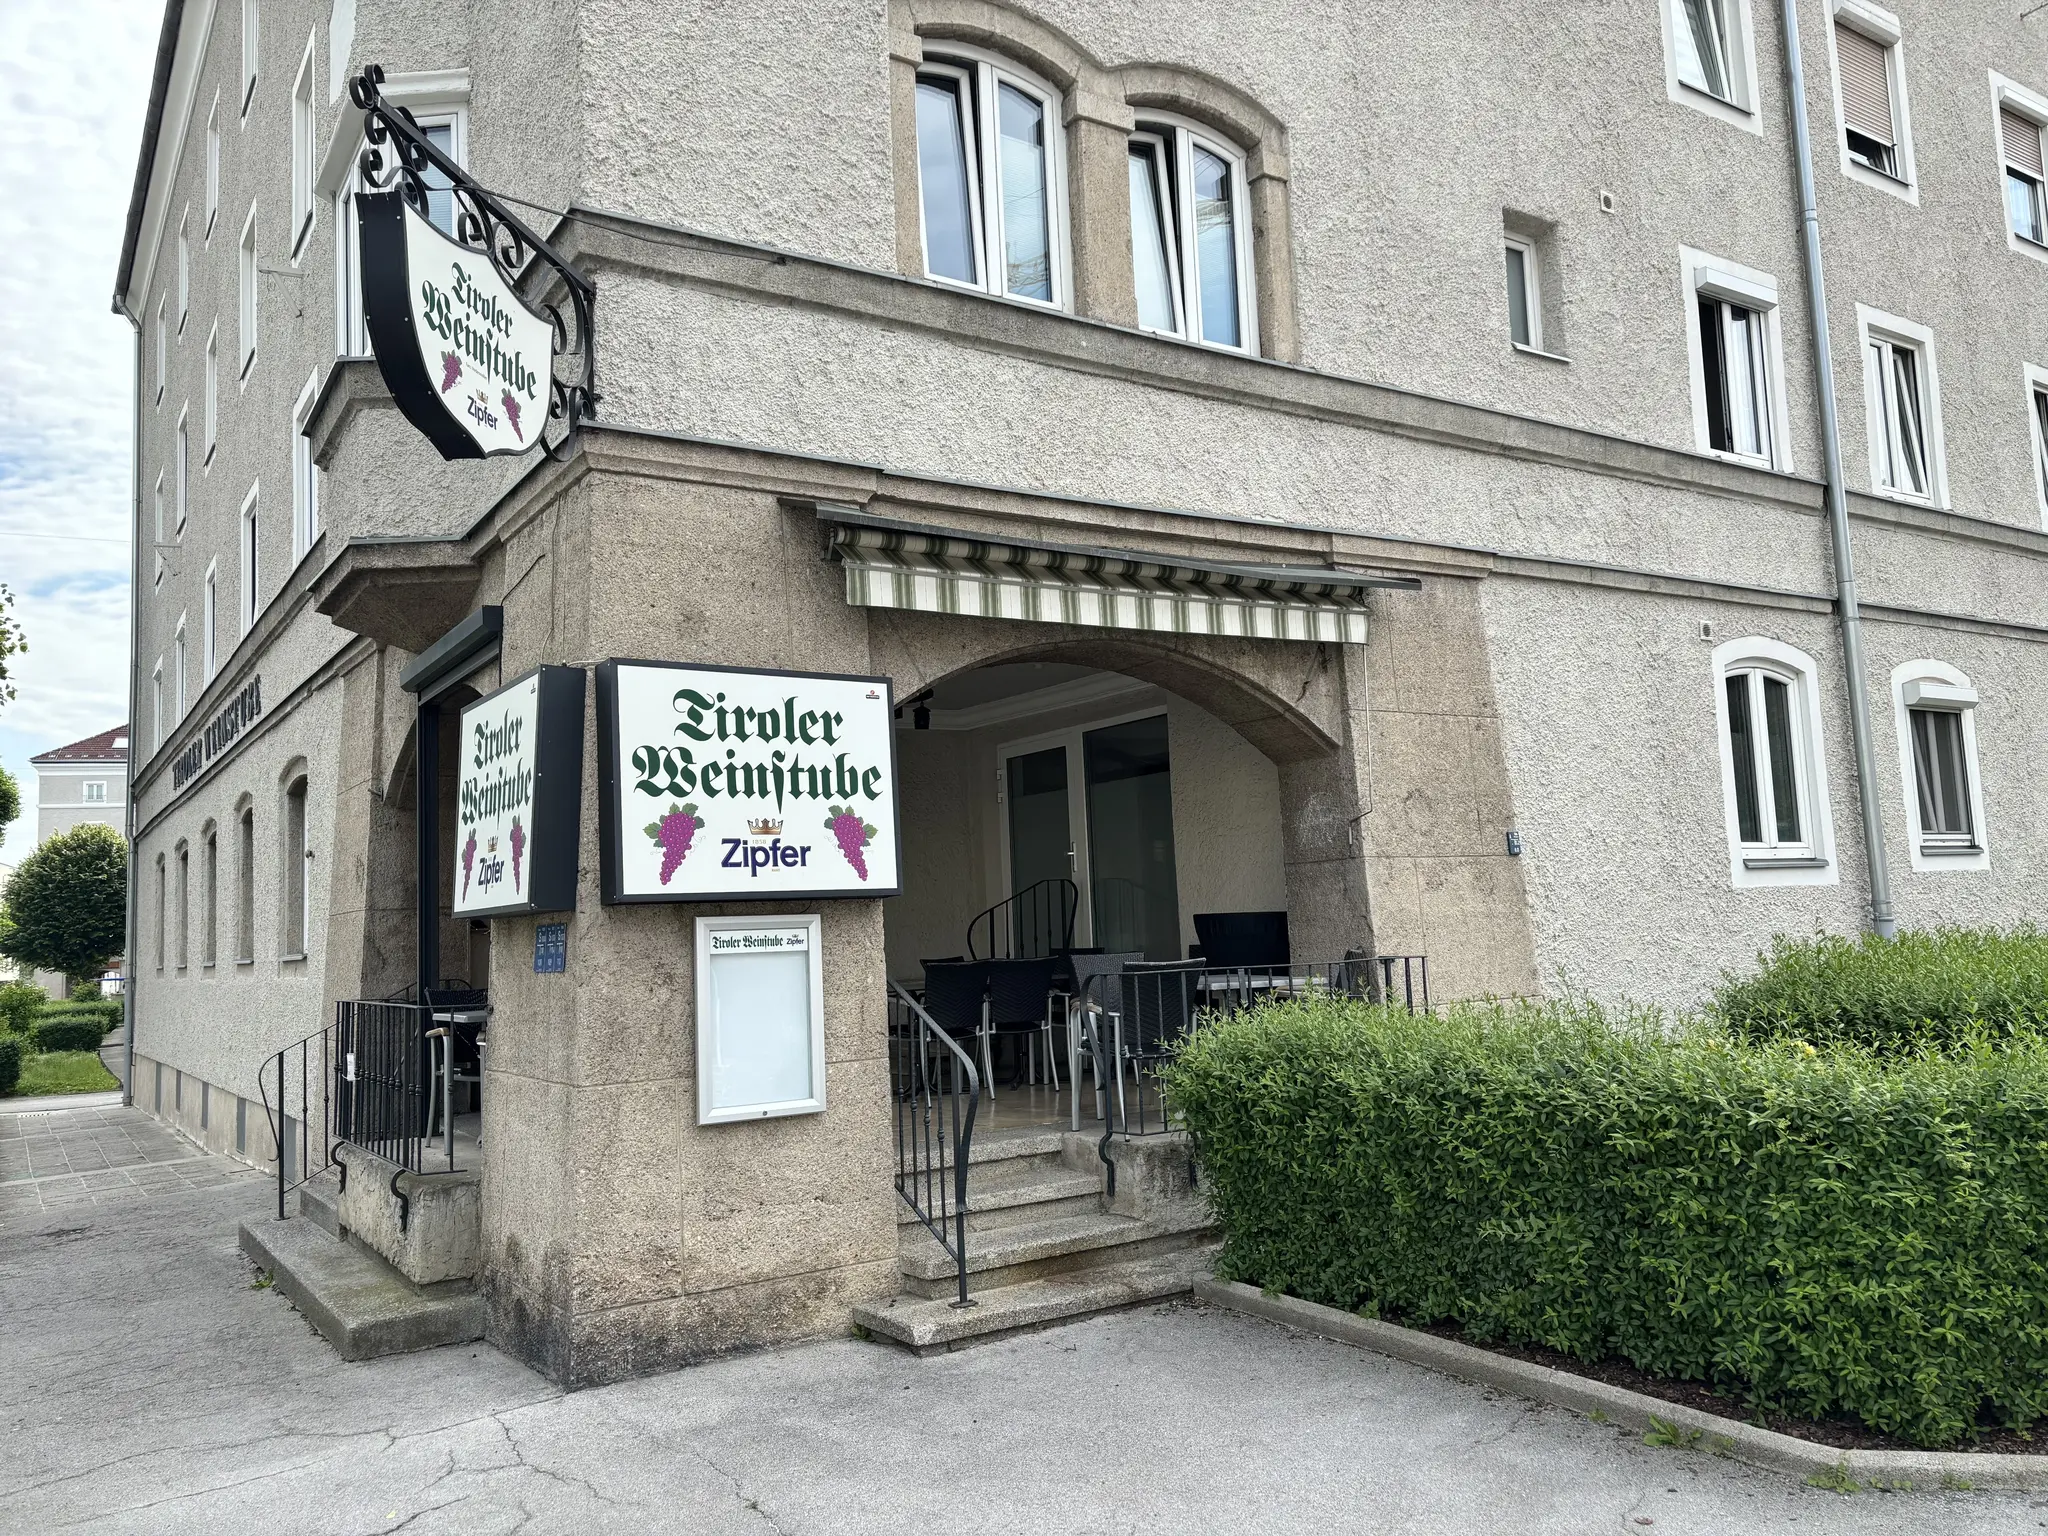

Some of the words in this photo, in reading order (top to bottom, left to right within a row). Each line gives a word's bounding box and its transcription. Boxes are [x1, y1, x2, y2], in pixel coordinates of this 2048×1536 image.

[452, 262, 513, 339] Tiroler
[467, 395, 498, 430] Zipfer
[673, 688, 844, 747] Tiroler
[473, 707, 523, 770] Tiroler
[478, 854, 505, 894] Zipfer
[721, 837, 812, 877] Zipfer
[712, 936, 741, 949] Tiroler
[786, 937, 805, 946] Zipfer
